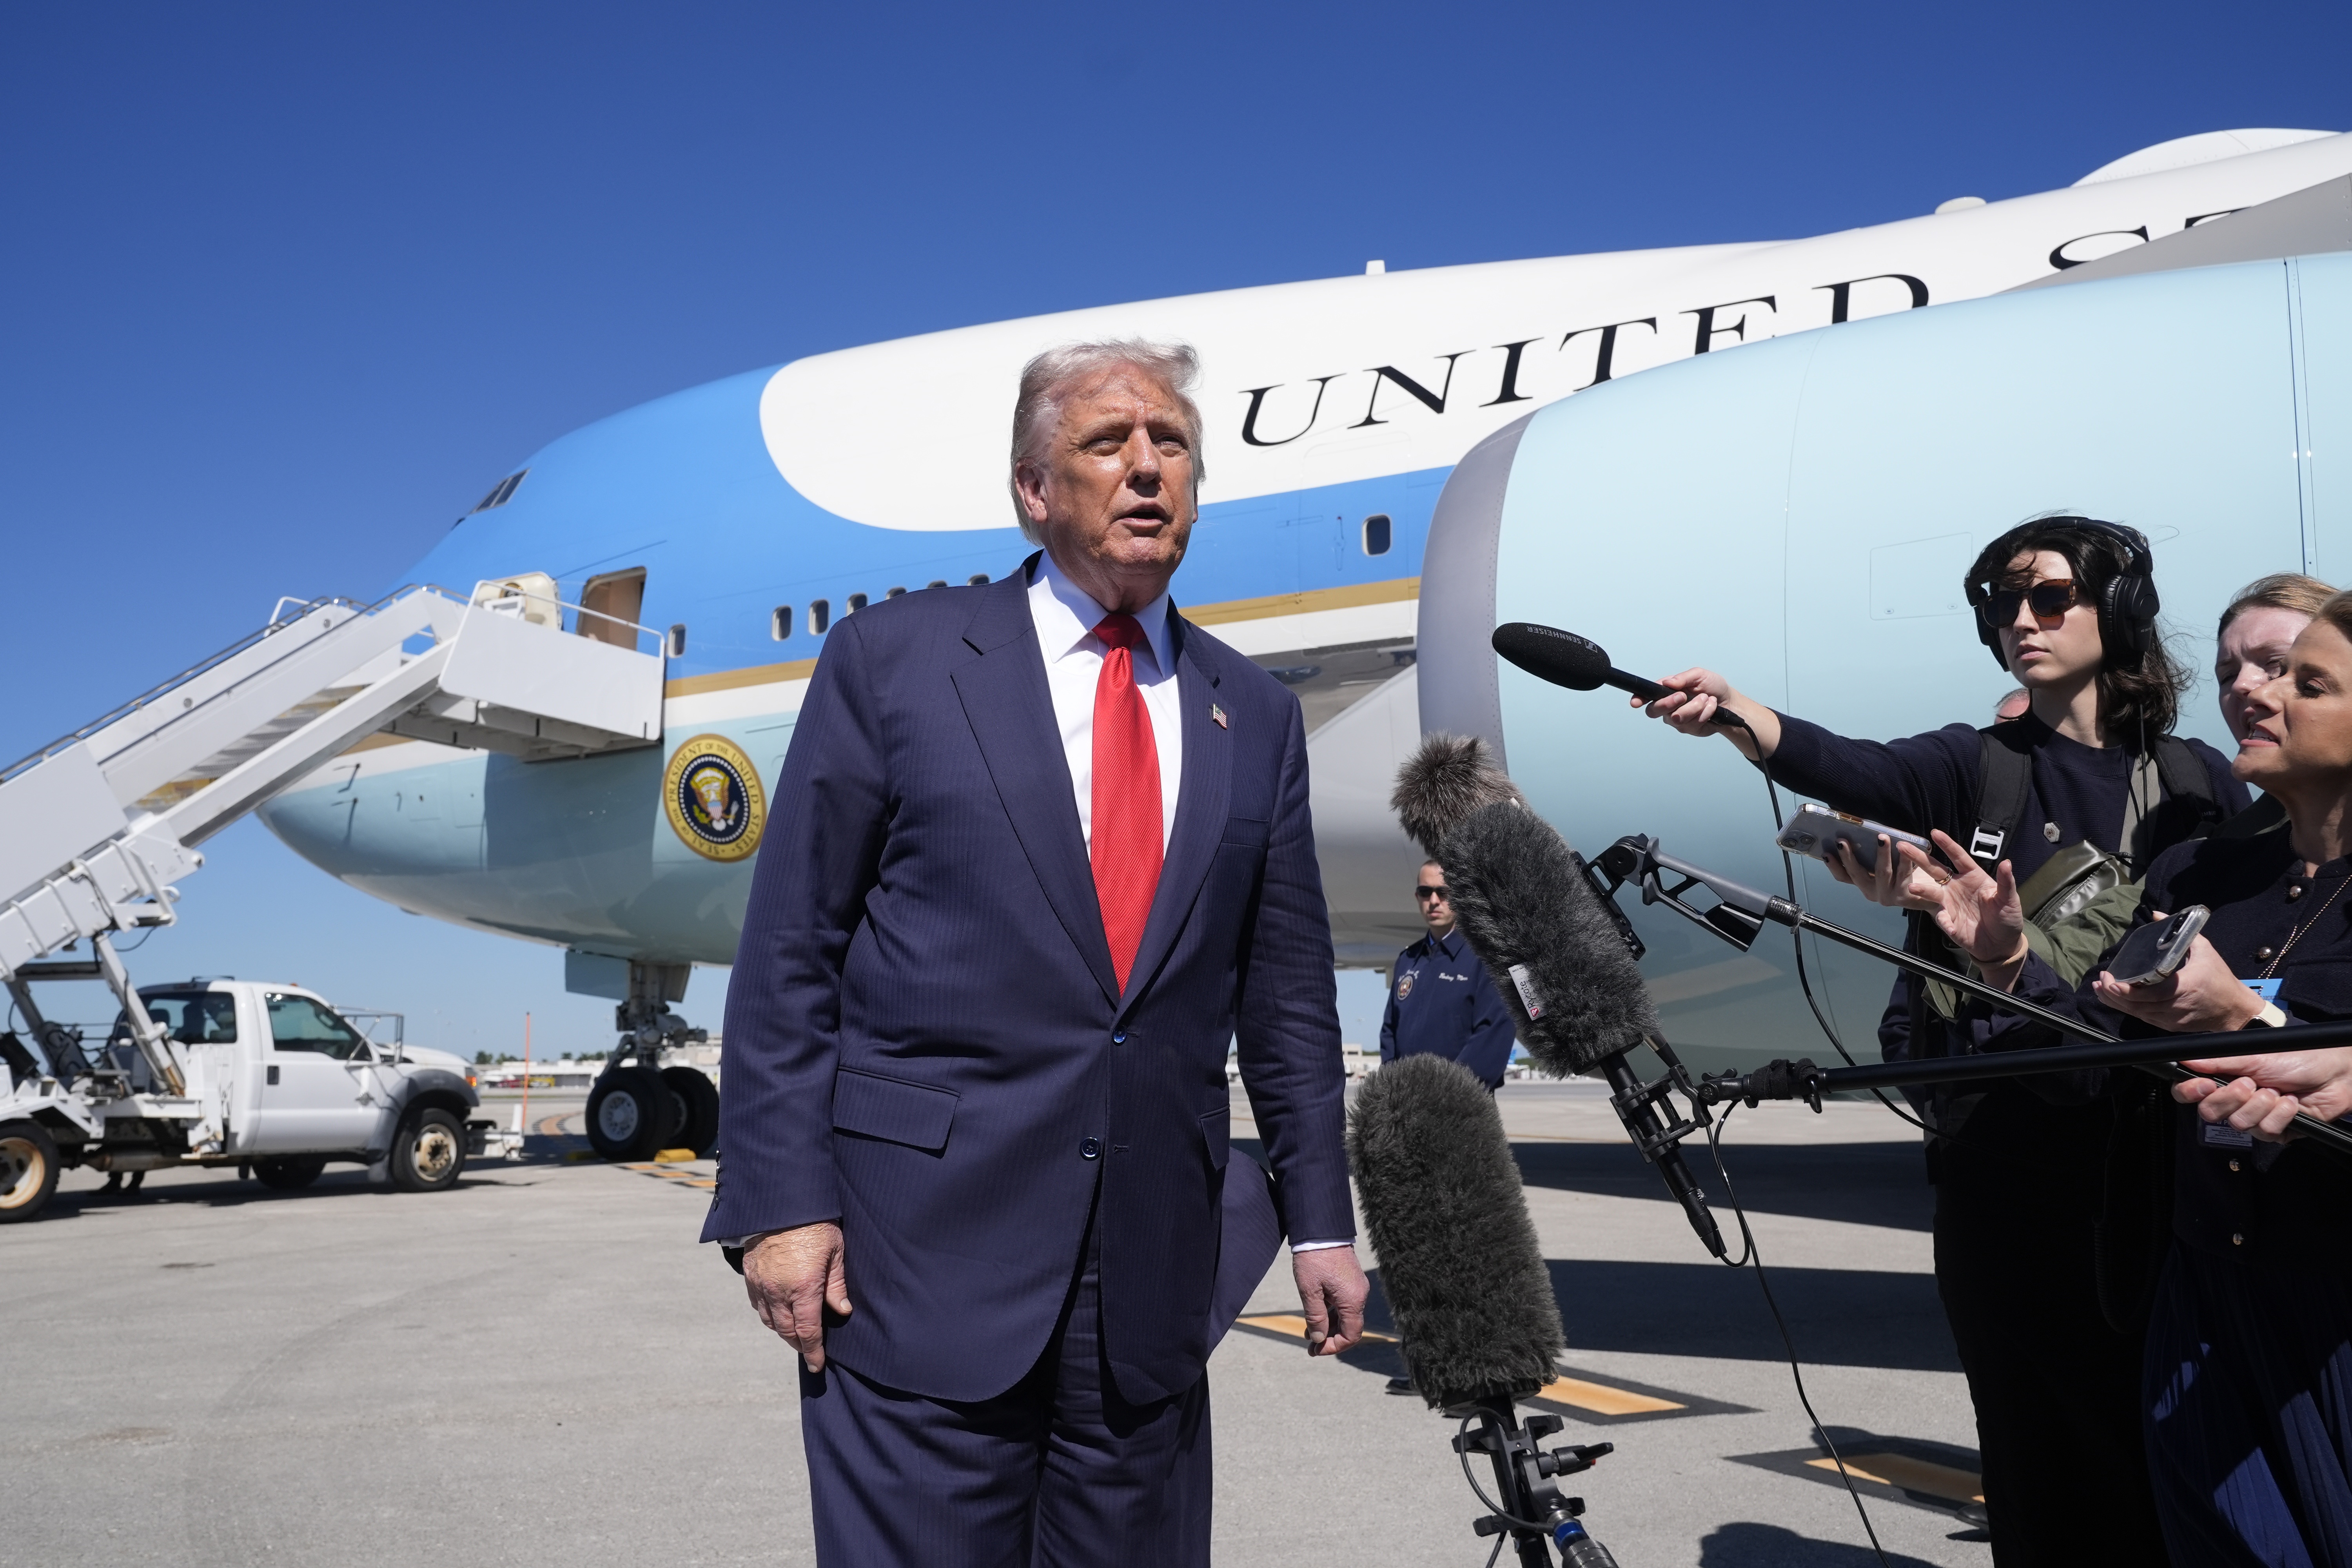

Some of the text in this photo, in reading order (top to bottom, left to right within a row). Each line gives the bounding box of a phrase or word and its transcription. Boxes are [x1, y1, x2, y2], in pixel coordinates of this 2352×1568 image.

[1239, 273, 1930, 448] UNITED
[1526, 626, 1582, 644] SENNHEISER
[717, 744, 728, 755] THE
[668, 742, 702, 802] PRESIDENT
[731, 753, 759, 803] UNITED
[681, 826, 690, 836] OF
[692, 834, 720, 855] SEAL
[735, 813, 760, 853] STATES
[1520, 981, 1536, 1009] Rycote
